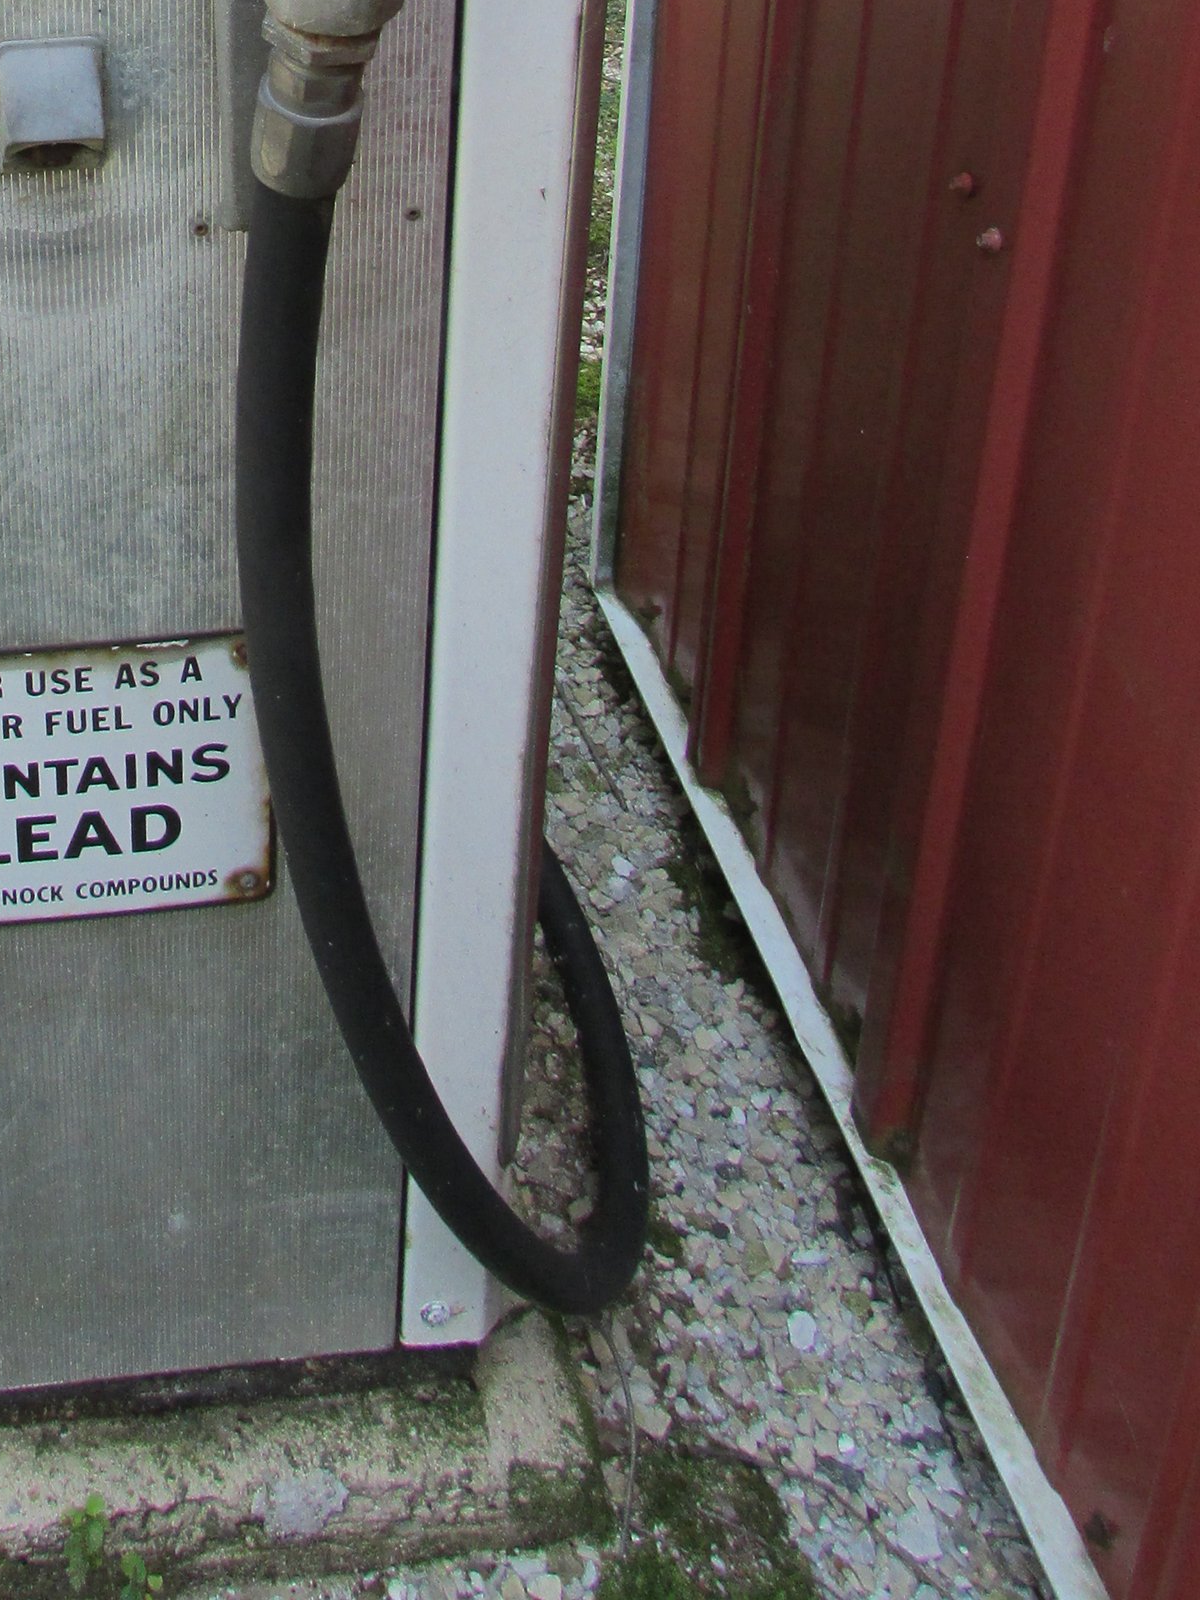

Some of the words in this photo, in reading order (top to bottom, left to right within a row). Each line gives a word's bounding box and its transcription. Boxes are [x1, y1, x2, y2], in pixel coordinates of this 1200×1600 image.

[25, 666, 94, 697] USE
[115, 660, 160, 689] AS
[180, 656, 203, 683] A
[45, 705, 133, 736] FUEL
[152, 693, 242, 726] ONLY
[75, 869, 219, 900] COMPOUNDS
